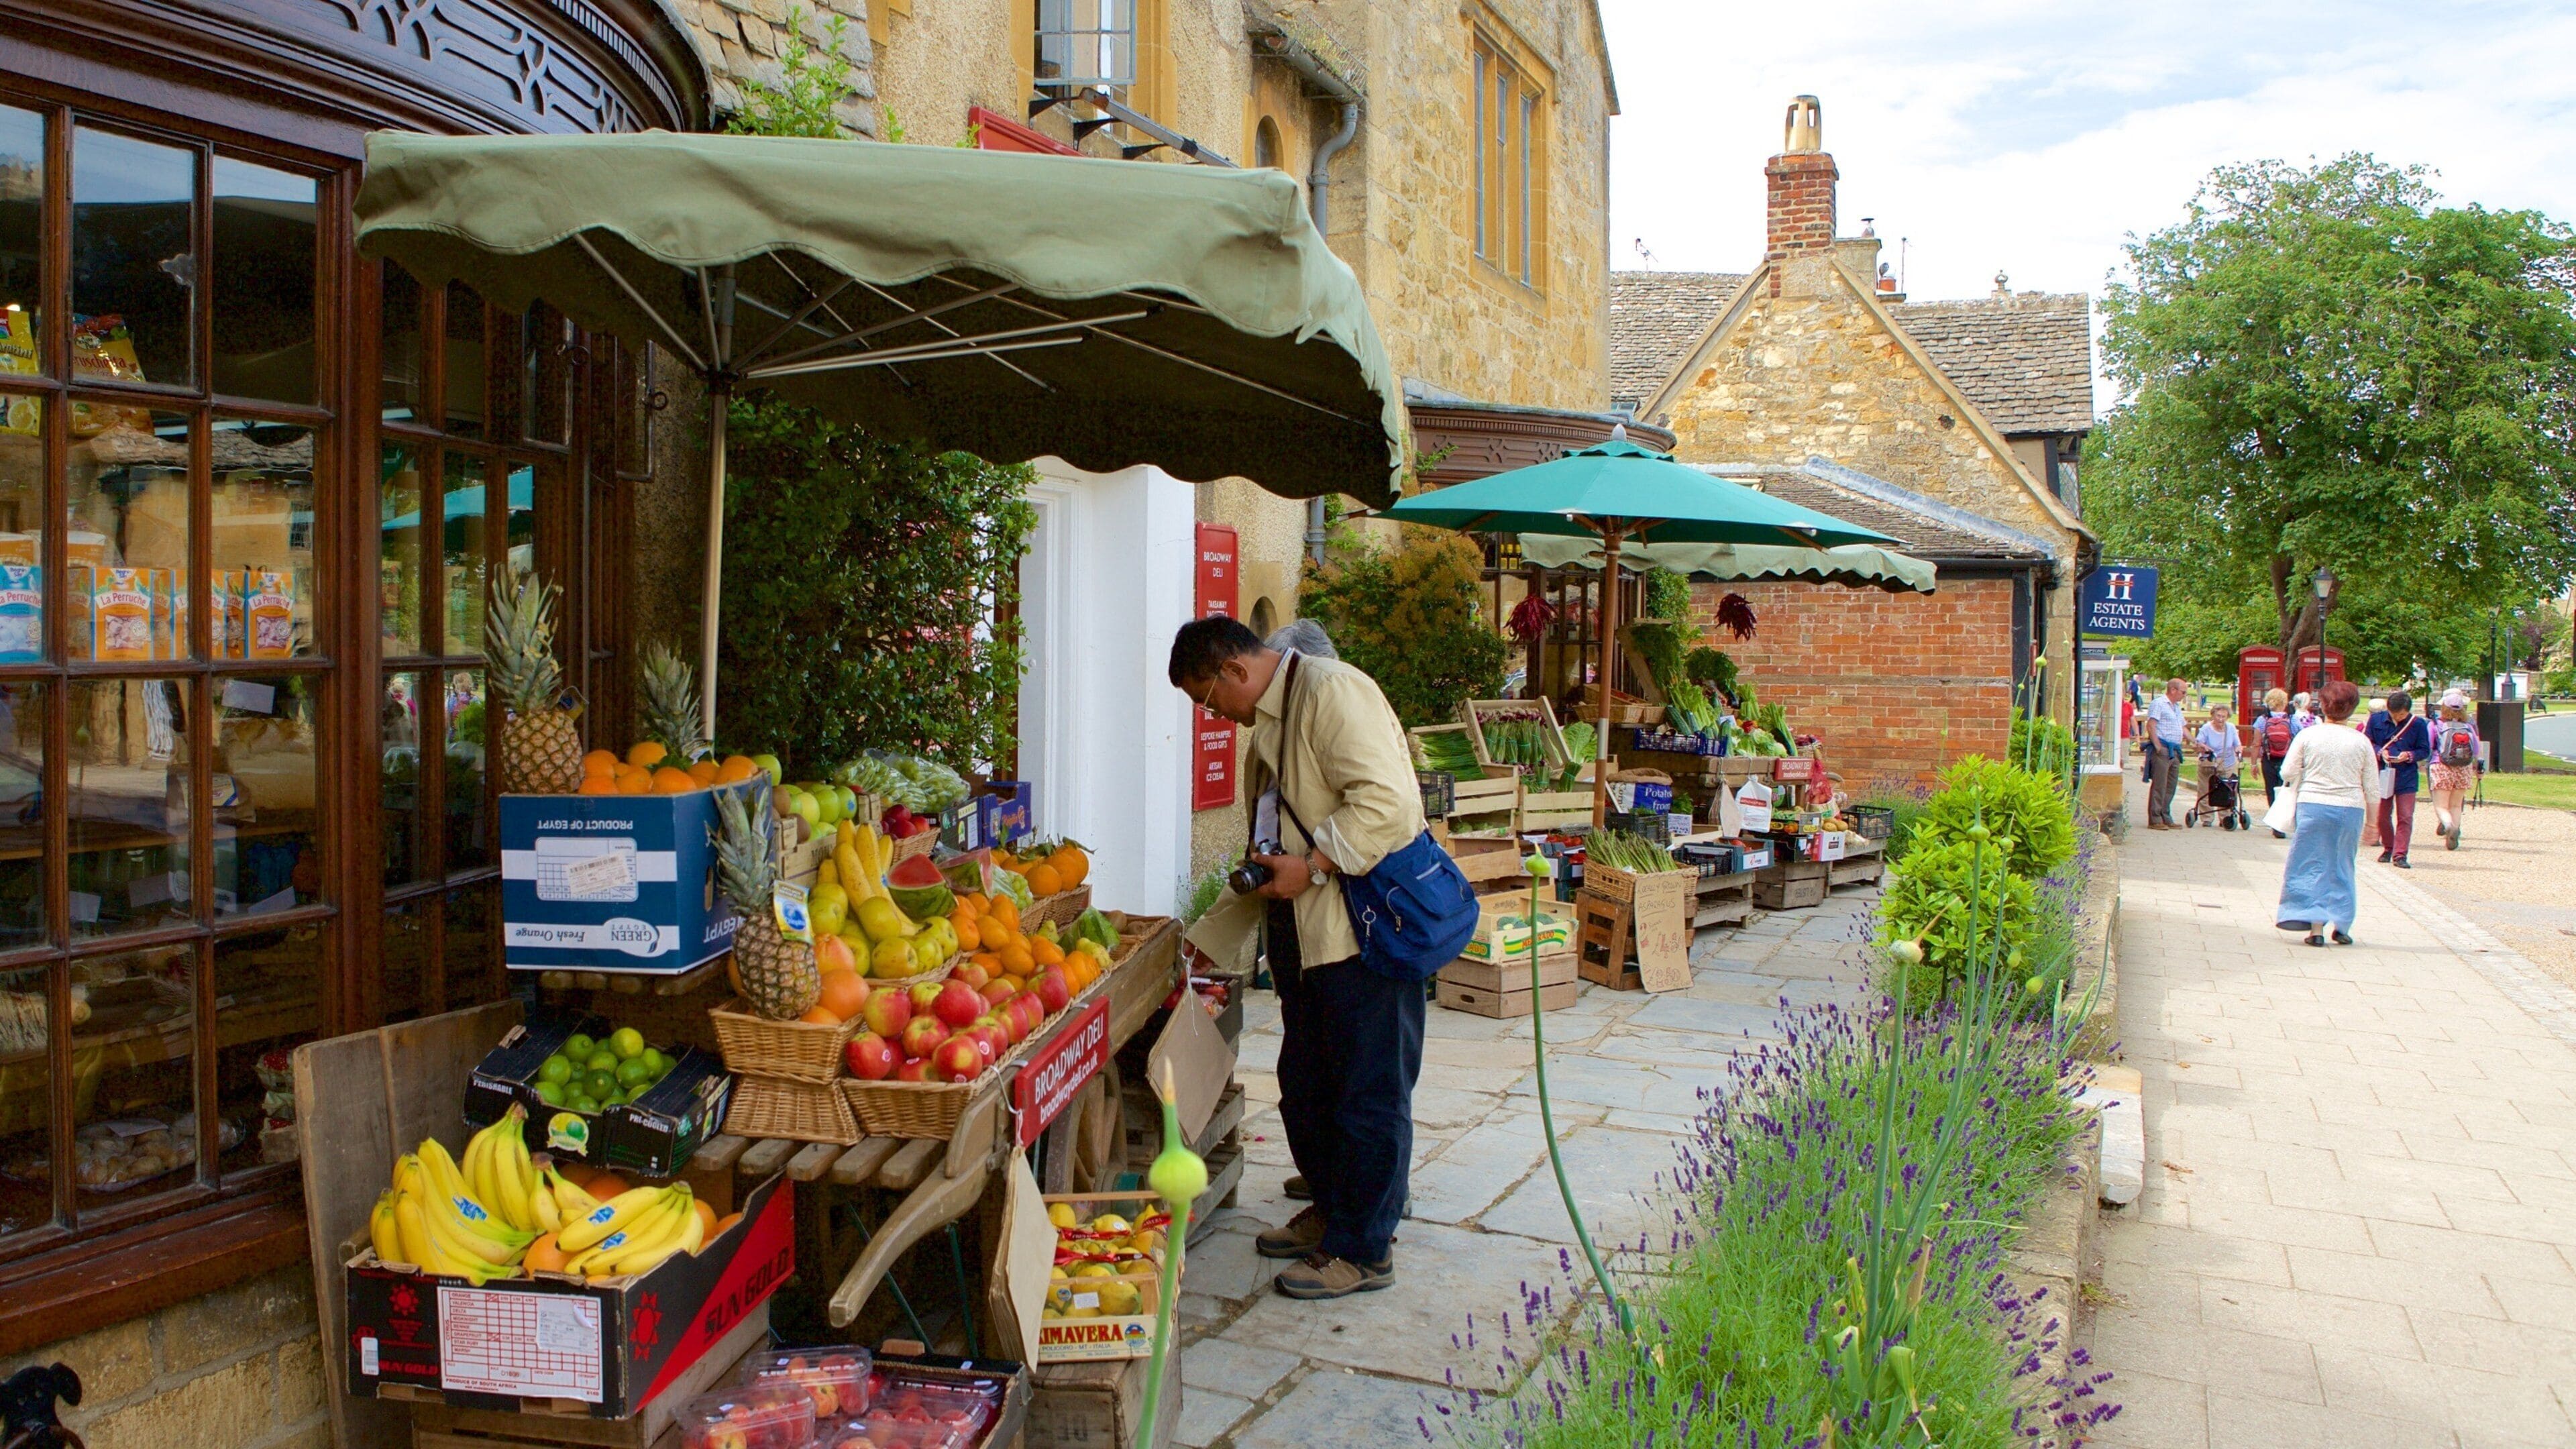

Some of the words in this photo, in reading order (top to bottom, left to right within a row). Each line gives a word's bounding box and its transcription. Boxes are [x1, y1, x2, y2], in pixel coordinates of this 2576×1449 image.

[73, 354, 127, 369] ruscheta
[1203, 551, 1232, 563] BROADWAY
[1212, 567, 1223, 578] DELI
[2106, 572, 2134, 600] H
[101, 596, 111, 605] La
[112, 592, 147, 606] Perruche
[252, 598, 262, 608] La
[262, 595, 290, 608] Perruche
[2092, 602, 2143, 616] ESTATE
[2088, 616, 2145, 631] AGENTS
[1782, 761, 1803, 770] BROADWAY
[538, 820, 568, 830] EGYPT
[570, 820, 583, 830] OF
[586, 820, 633, 830] PRODUCT
[515, 928, 553, 942] Orange
[557, 931, 586, 942] Fresh
[611, 930, 652, 942] GREEN
[703, 917, 736, 943] EGYPT
[1035, 1030, 1086, 1104] BROADWAY
[1087, 1012, 1104, 1051] DELI
[473, 1079, 513, 1095] PERISHABLE
[1040, 1051, 1098, 1124] broadwaydeli.co.uk
[704, 1283, 743, 1344] SUN
[745, 1246, 790, 1306] GOLD
[1039, 1324, 1124, 1344] IMAVERA
[379, 1359, 402, 1372] UN
[404, 1362, 439, 1375] GOLD
